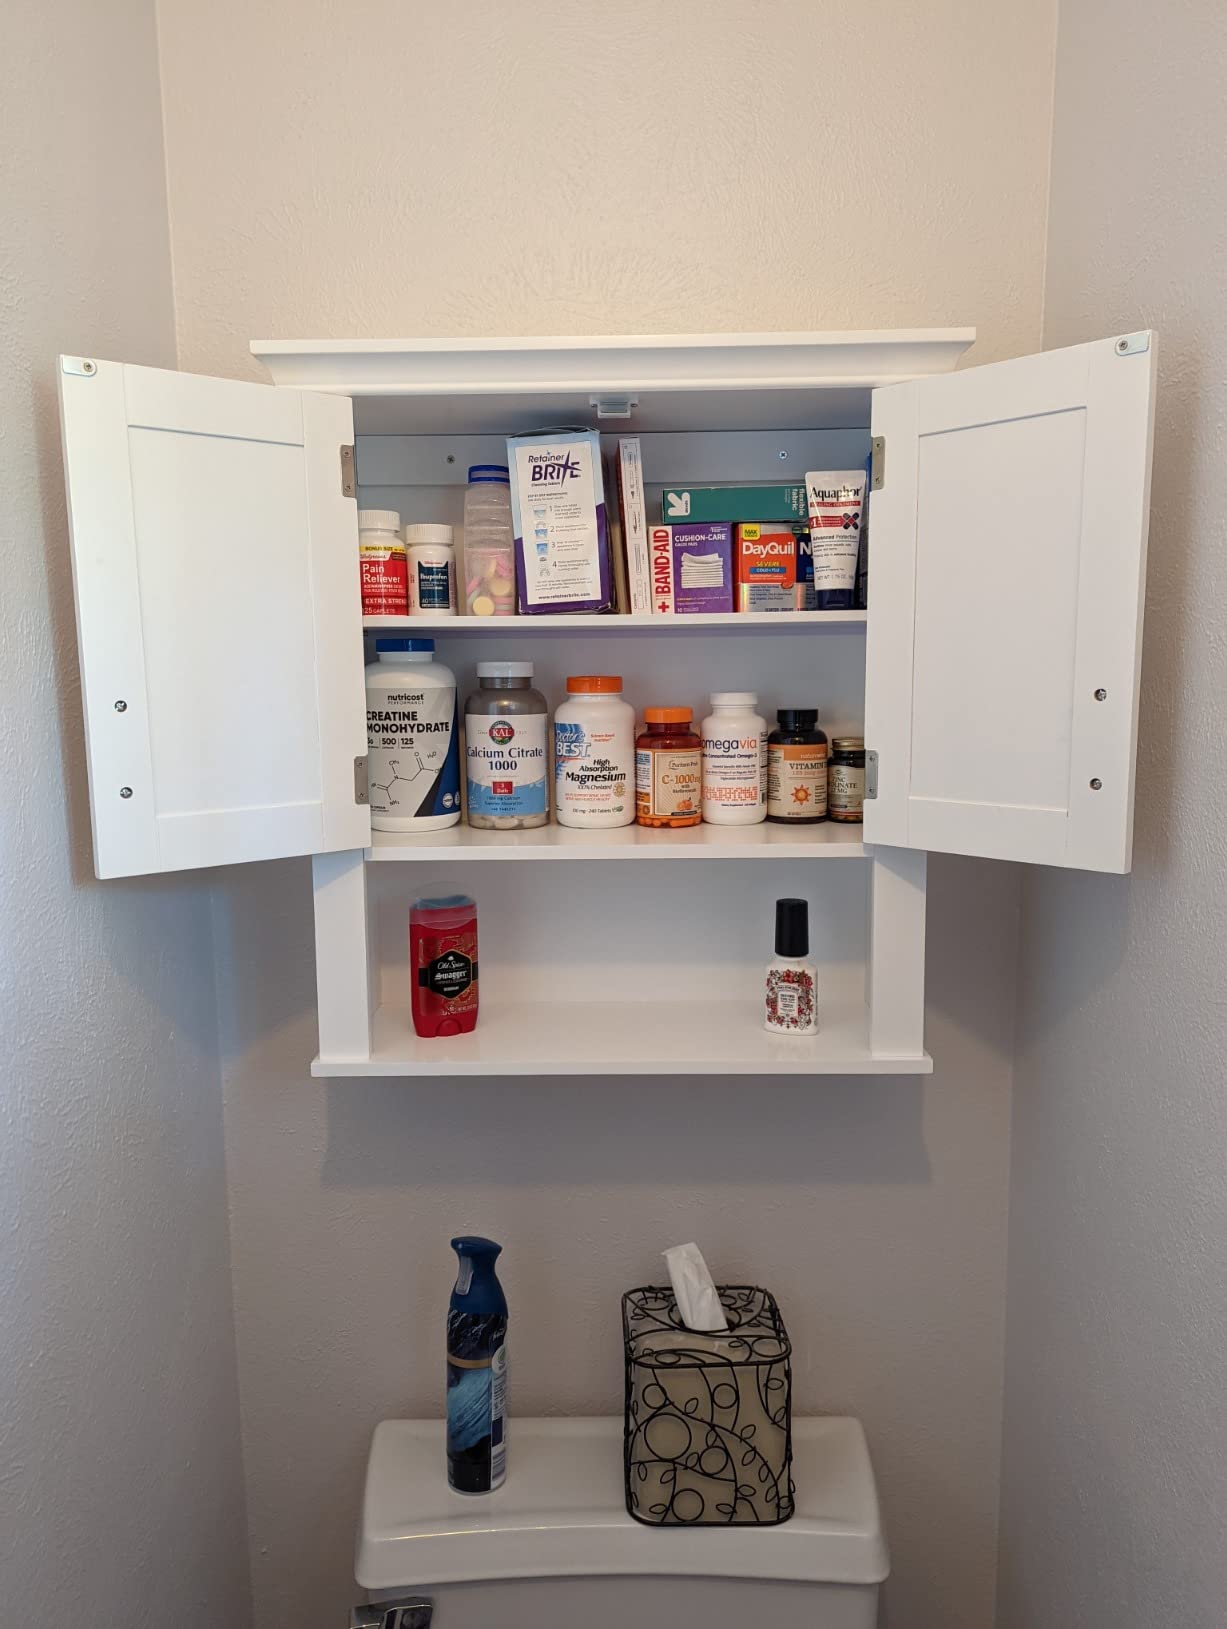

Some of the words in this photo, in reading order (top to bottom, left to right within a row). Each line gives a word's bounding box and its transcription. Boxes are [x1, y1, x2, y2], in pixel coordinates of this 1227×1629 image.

[528, 454, 565, 464] Retainer
[810, 486, 861, 502] Aquaphor
[675, 533, 727, 542] CUSHION-CARE
[742, 541, 795, 559] DayQuil
[362, 563, 385, 573] Pain
[363, 573, 400, 583] Reliever
[387, 693, 424, 701] nutricost
[366, 711, 418, 721] CREATINE
[367, 722, 450, 733] MONOHYDRATE
[492, 729, 511, 737] KAL
[467, 747, 504, 758] Calcium
[508, 747, 543, 758] Citrate
[557, 743, 591, 757] BEST
[488, 760, 518, 771] 1000
[593, 758, 610, 767] High
[789, 762, 824, 770] VITAMIN
[579, 765, 619, 773] Absorption
[565, 772, 627, 785] Magnesium
[437, 961, 450, 970] Old
[434, 970, 468, 981] Swagger
